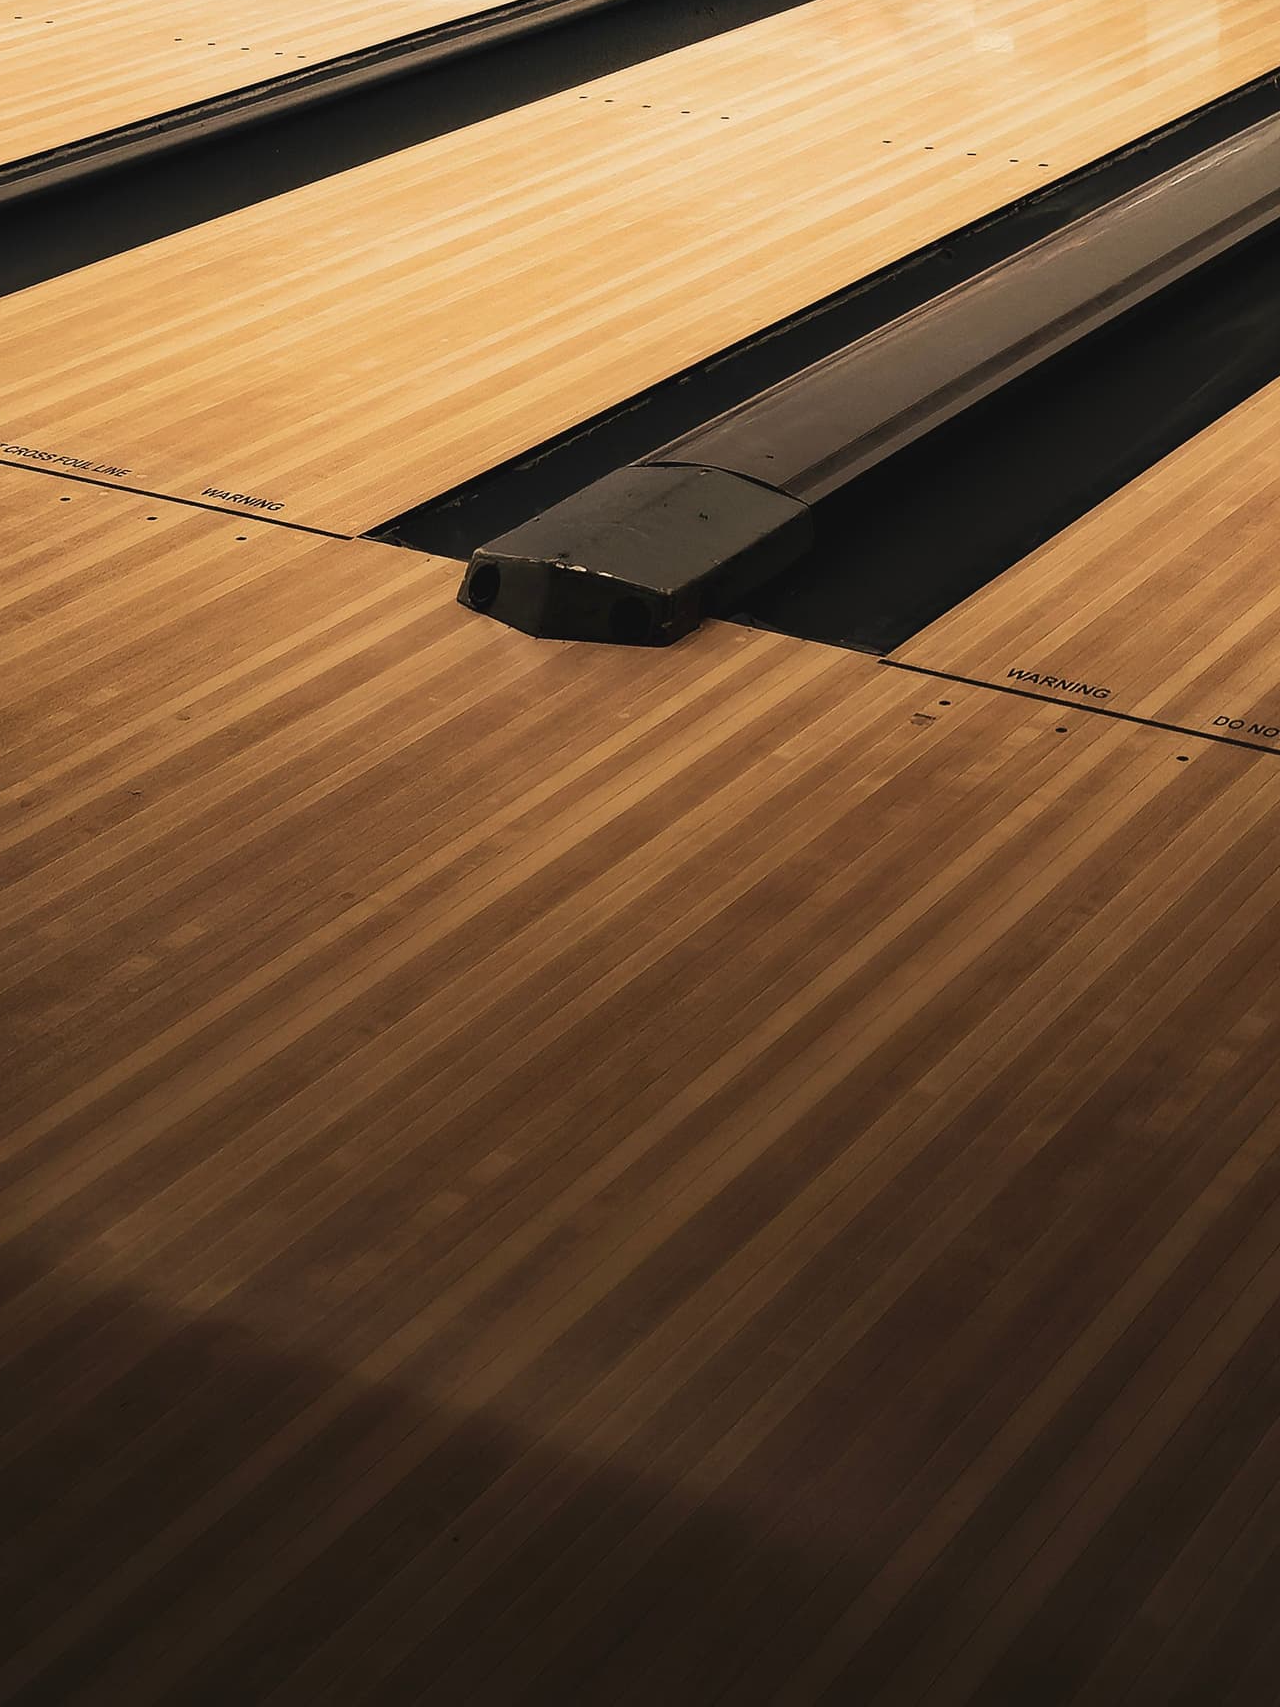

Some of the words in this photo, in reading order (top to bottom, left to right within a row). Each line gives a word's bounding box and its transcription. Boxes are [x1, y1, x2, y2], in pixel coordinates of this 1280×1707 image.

[3, 446, 58, 462] CROSS
[53, 456, 93, 470] FOUL
[92, 464, 132, 478] LINE
[200, 487, 286, 511] WARNING
[1006, 667, 1112, 700] WARNING
[1212, 715, 1245, 730] DO
